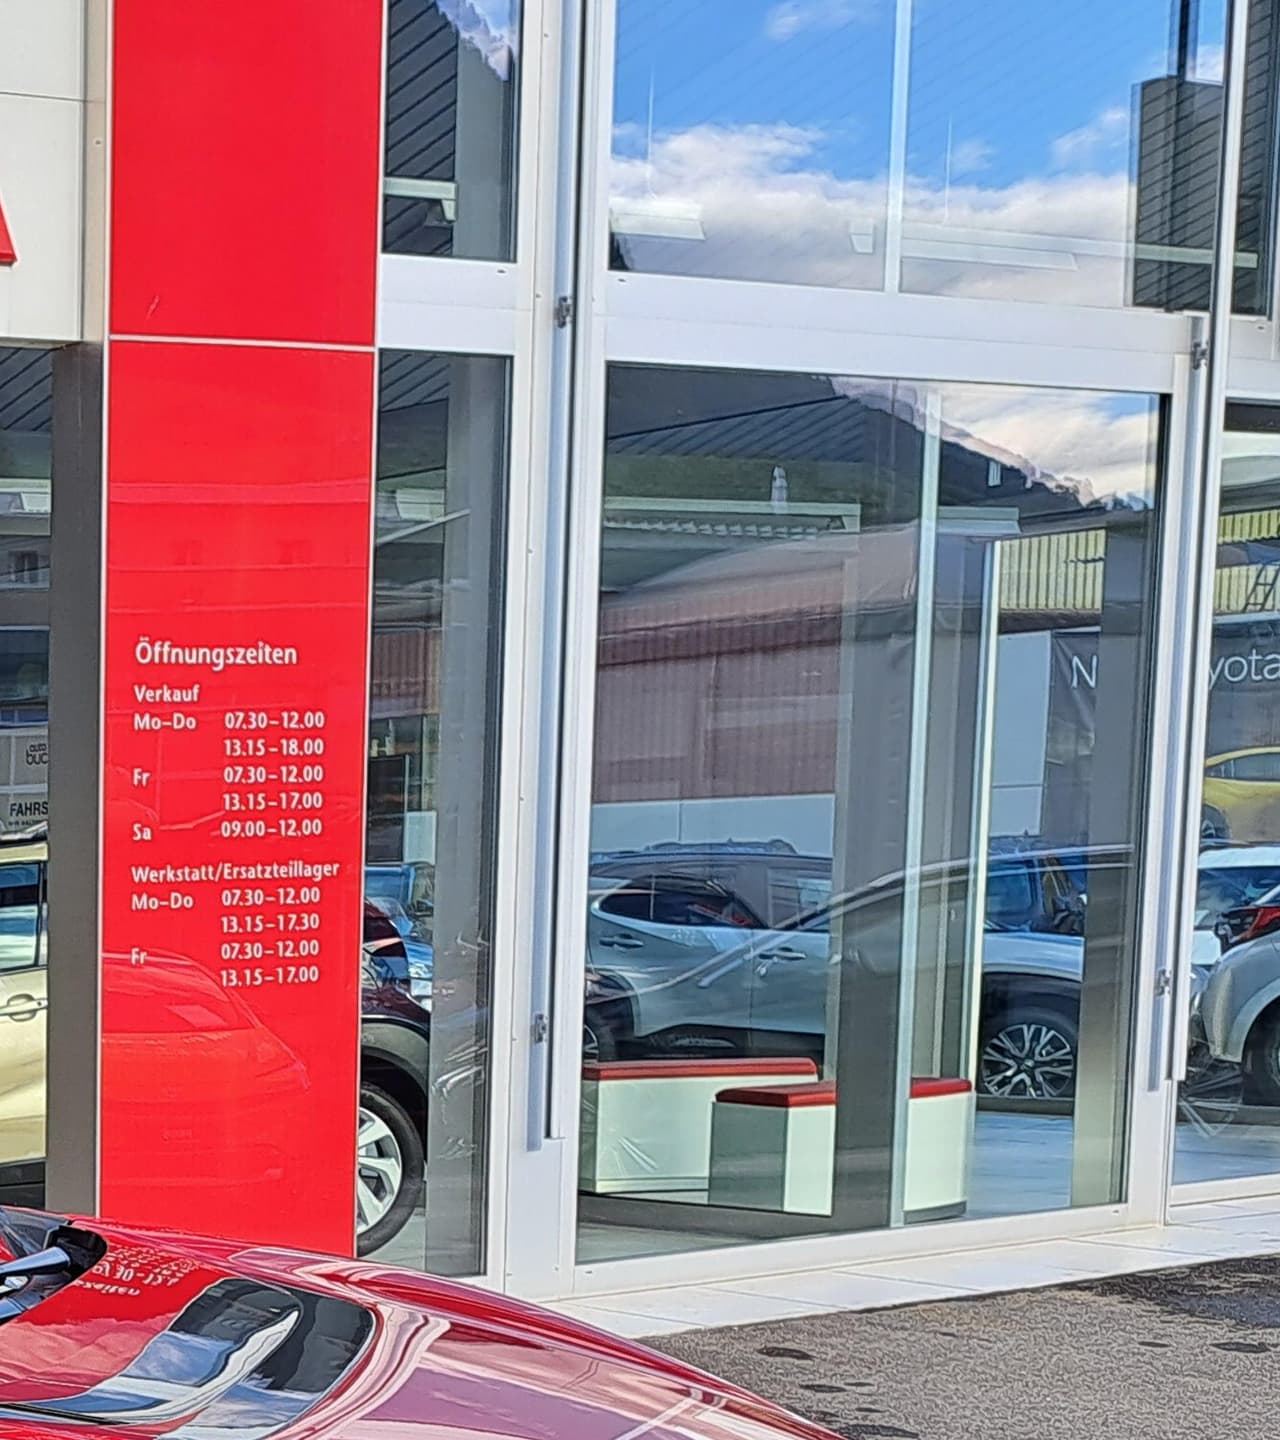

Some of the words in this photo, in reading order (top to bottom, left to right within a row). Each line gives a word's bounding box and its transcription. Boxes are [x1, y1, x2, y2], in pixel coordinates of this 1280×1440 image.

[135, 635, 297, 671] Öffnungszeiten
[134, 684, 200, 702] Verkauf
[133, 769, 150, 786] Fr
[133, 824, 151, 840] Sa
[131, 861, 340, 883] Werkstatt/Ersatzteillager
[131, 948, 147, 965] Fr
